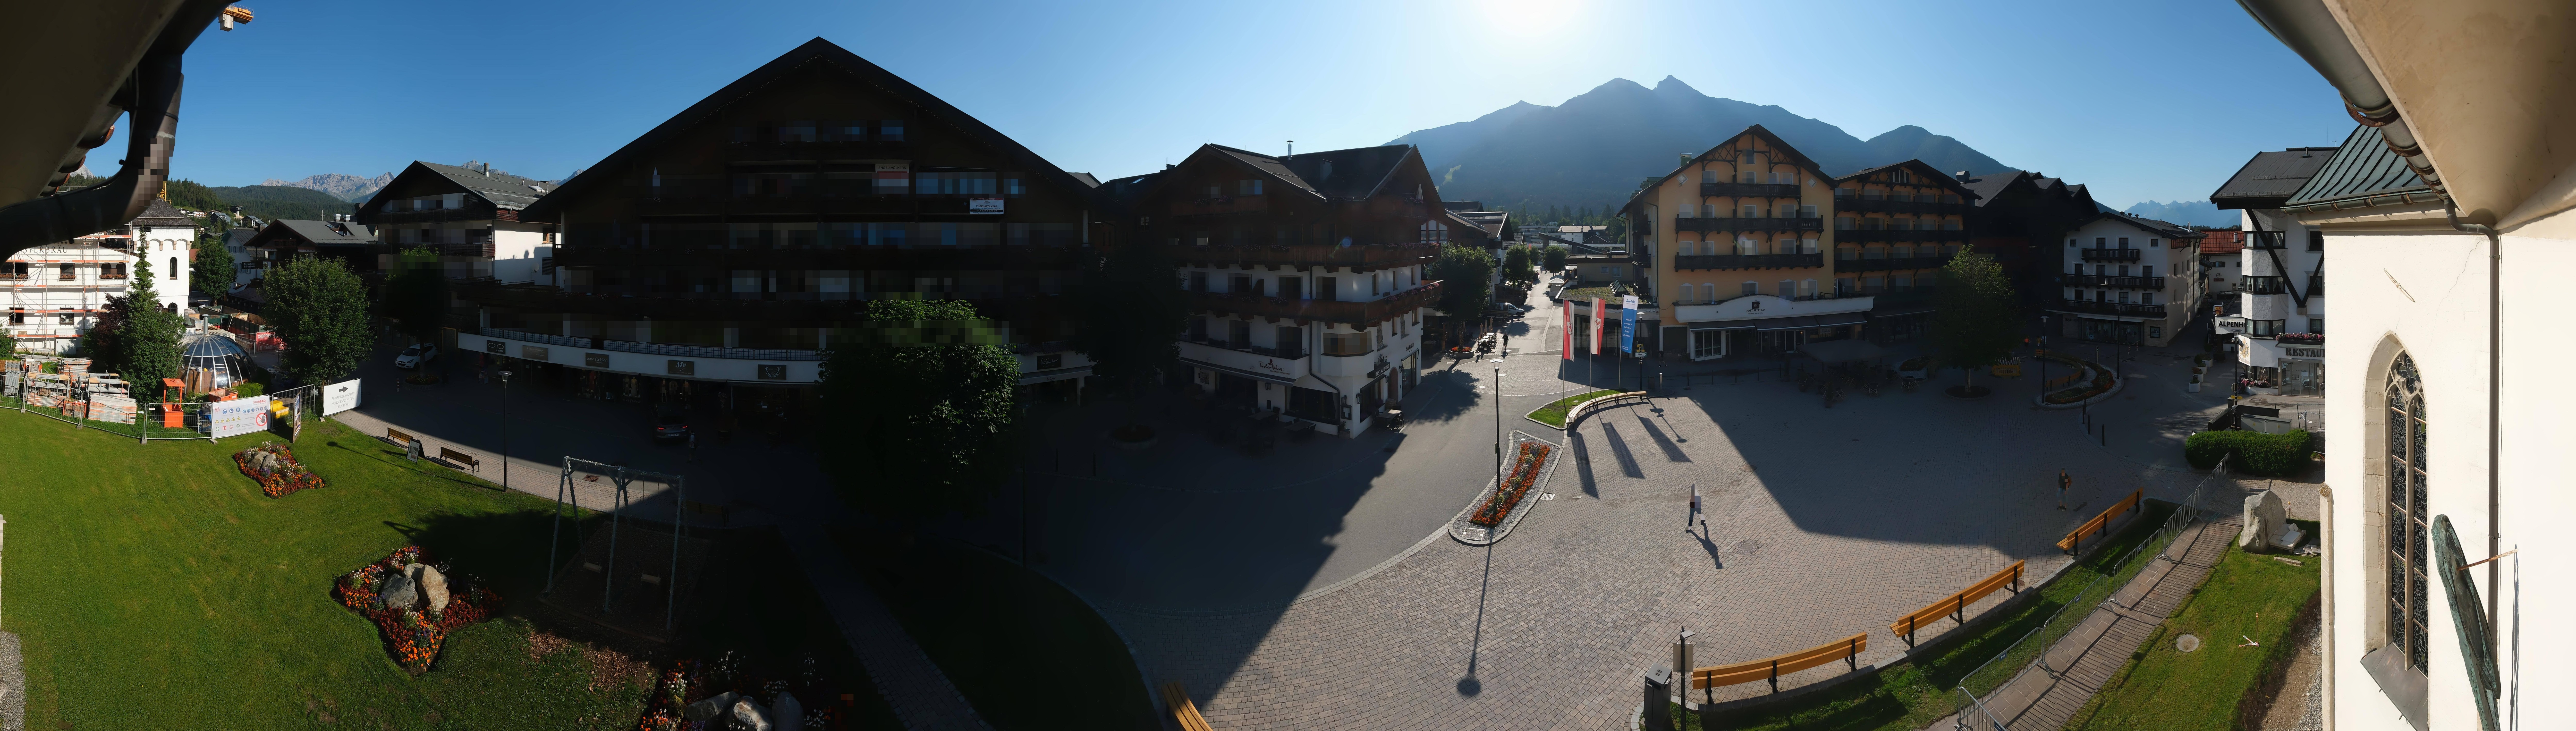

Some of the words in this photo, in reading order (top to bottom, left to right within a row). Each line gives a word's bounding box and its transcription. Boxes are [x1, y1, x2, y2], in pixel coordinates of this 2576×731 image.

[1406, 343, 1414, 351] SAILER
[1376, 364, 1389, 377] RESTAURANT
[332, 396, 354, 405] KONGRESSZENTRUM
